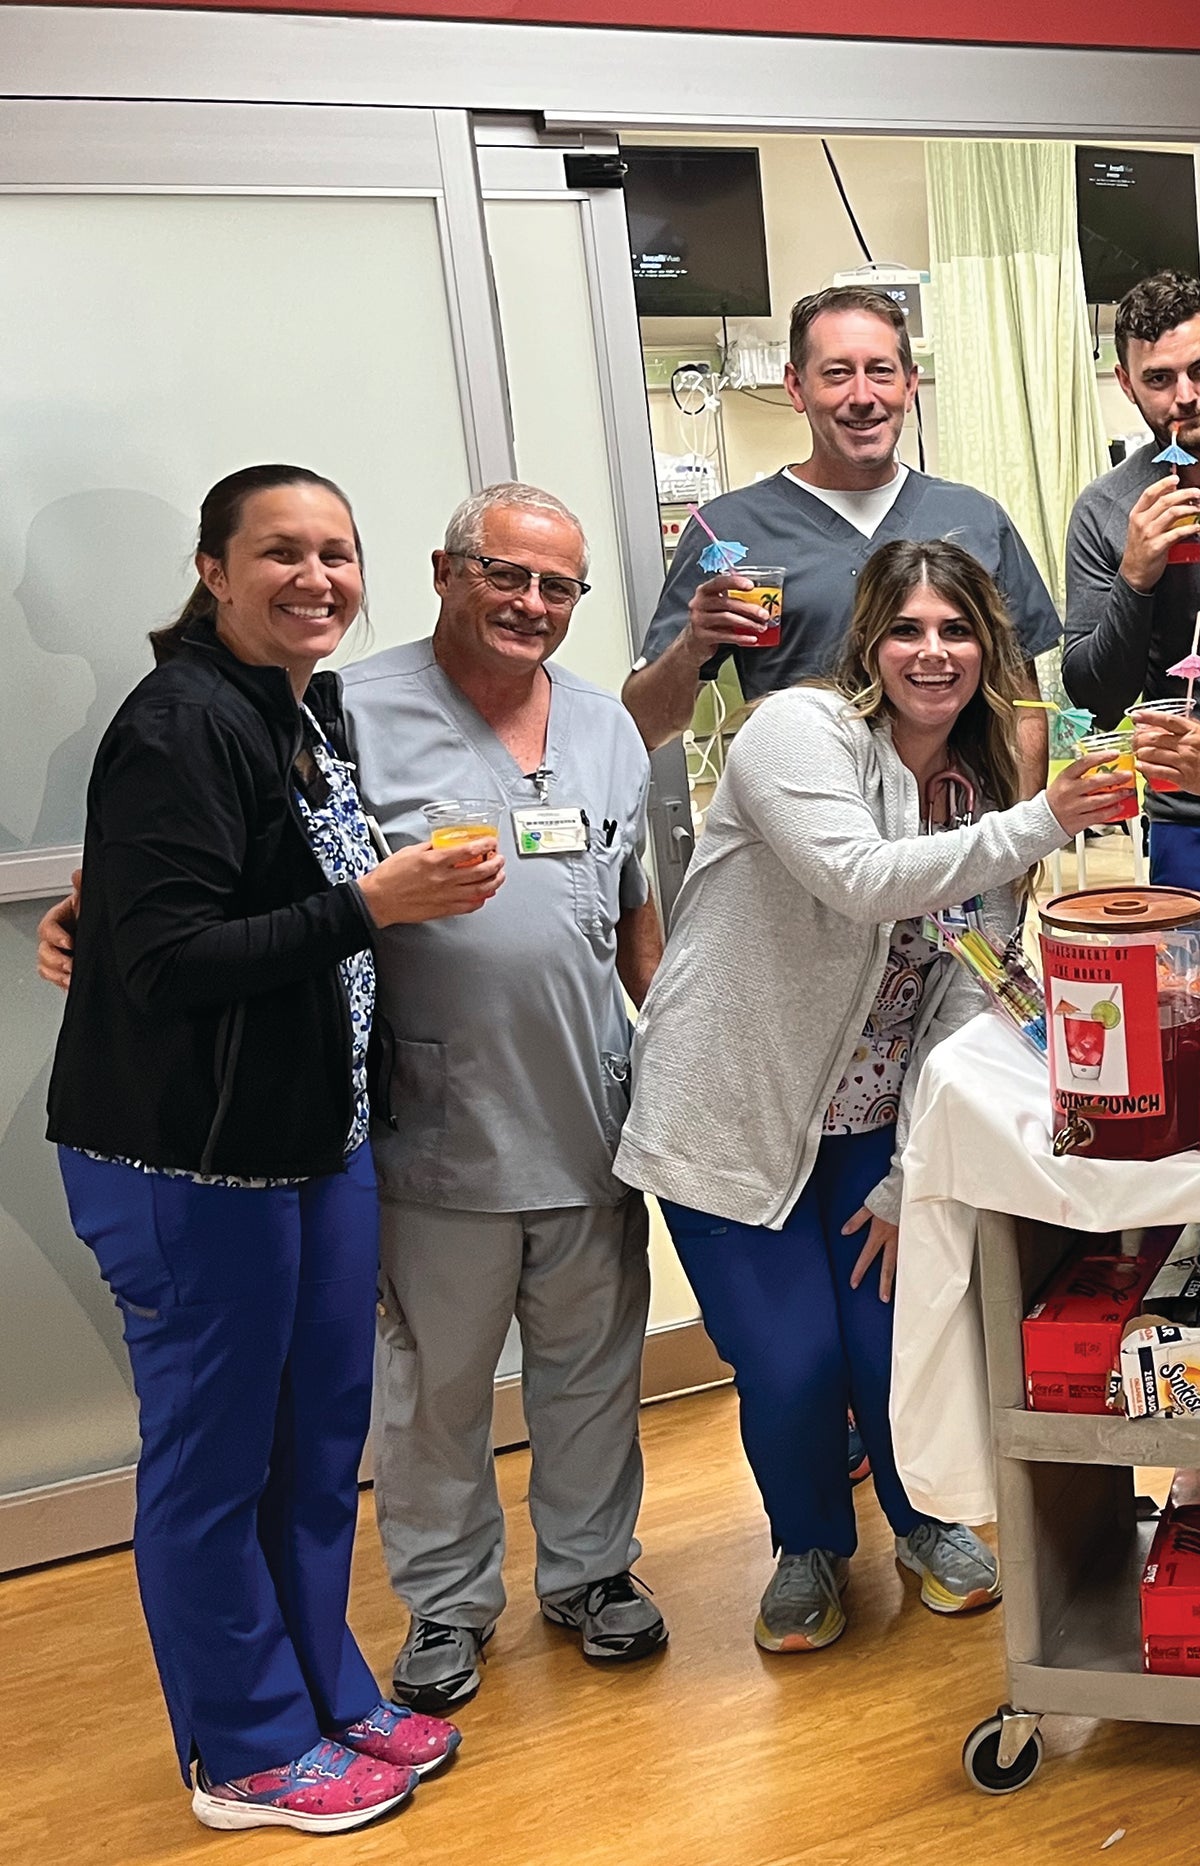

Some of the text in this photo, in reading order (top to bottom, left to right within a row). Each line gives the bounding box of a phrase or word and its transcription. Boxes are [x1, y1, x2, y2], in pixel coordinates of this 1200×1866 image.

[1115, 949, 1128, 960] OF
[1055, 964, 1068, 976] THE
[1099, 1094, 1160, 1114] PUNCH
[1144, 1370, 1154, 1393] ZERO
